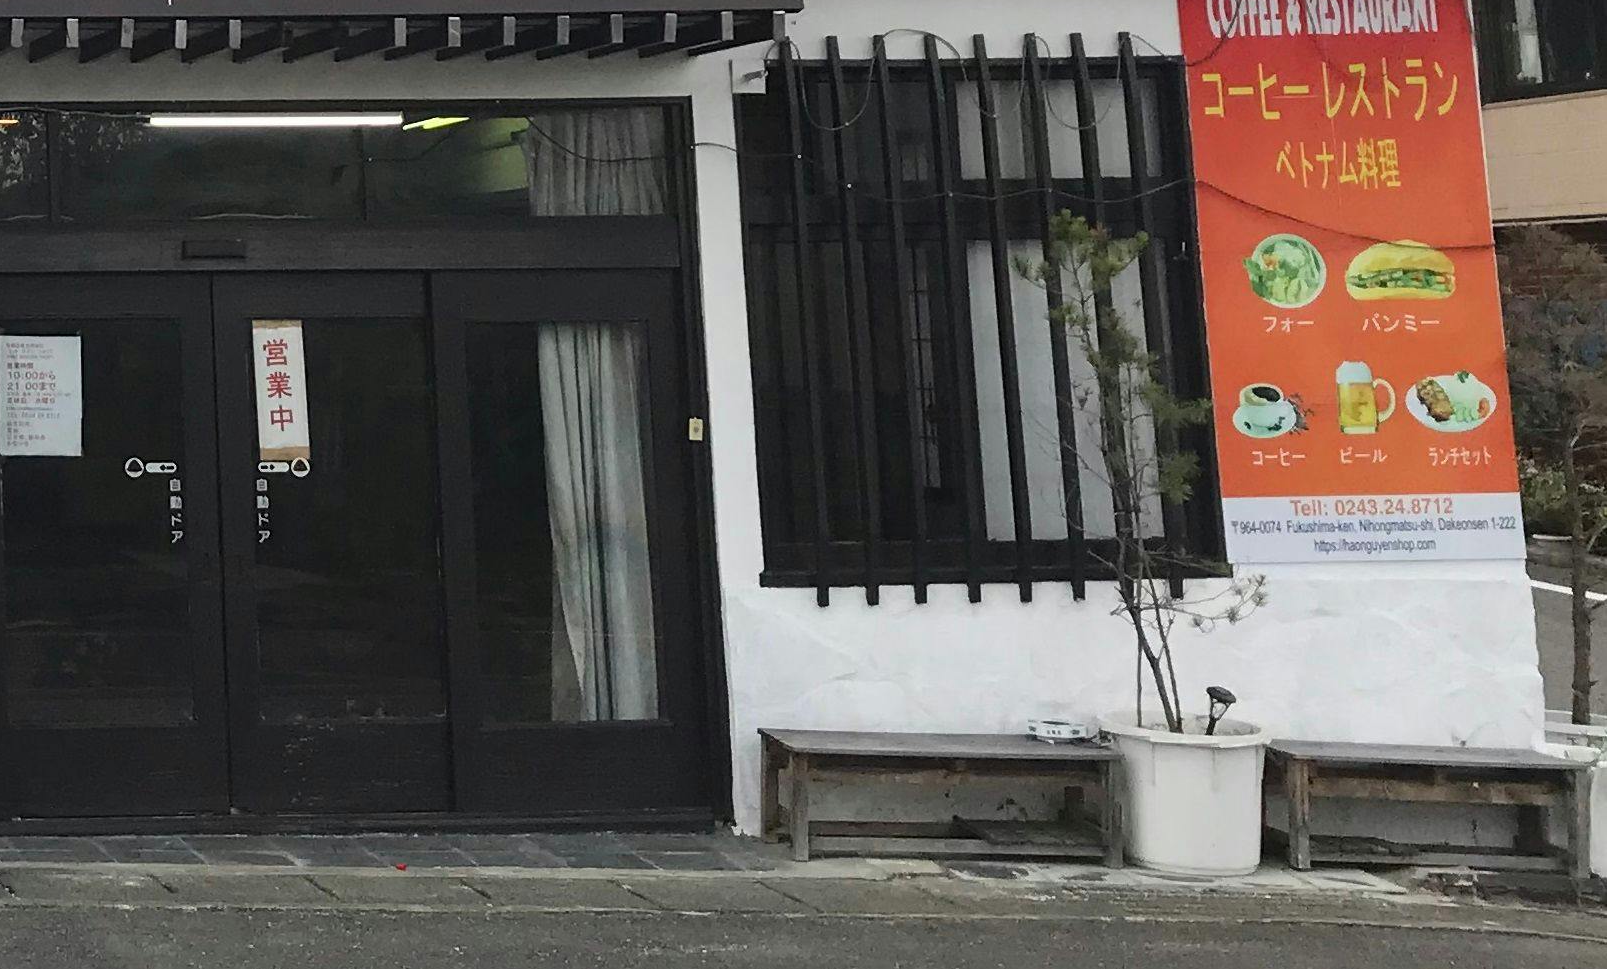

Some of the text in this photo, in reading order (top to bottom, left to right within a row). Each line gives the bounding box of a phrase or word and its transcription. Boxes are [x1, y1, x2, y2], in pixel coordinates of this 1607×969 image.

[1276, 137, 1402, 189] ベトナム料理
[1263, 316, 1315, 333] フォー
[263, 339, 294, 432] 営業中
[1251, 447, 1306, 467] コーヒー
[1428, 446, 1492, 467] ランチセット
[1335, 497, 1454, 515] 0243.24.8712
